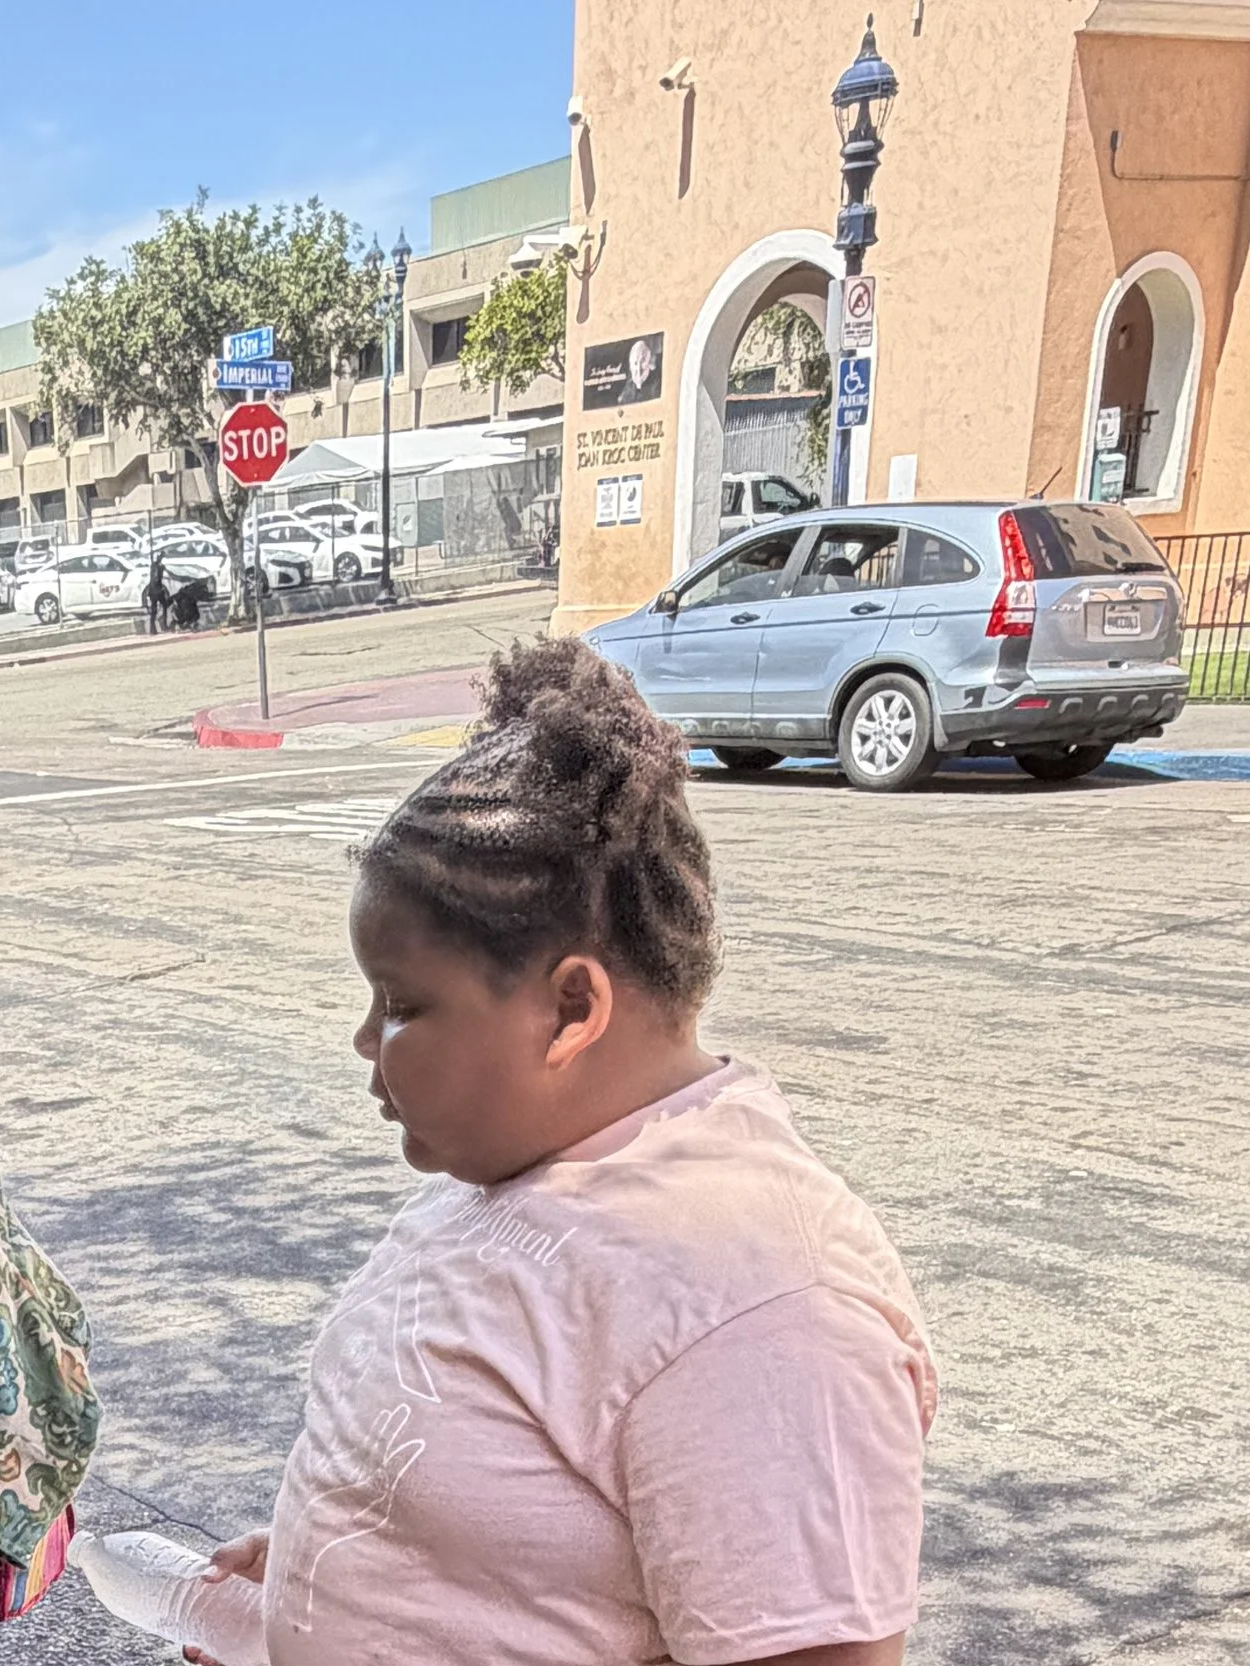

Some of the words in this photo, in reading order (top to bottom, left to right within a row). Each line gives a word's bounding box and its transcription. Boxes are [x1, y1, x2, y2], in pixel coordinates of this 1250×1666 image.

[235, 337, 258, 359] 15TH
[223, 364, 273, 385] IMPERIAL
[838, 392, 869, 408] PARKING
[844, 408, 863, 424] ONLY
[223, 426, 285, 462] STOP
[591, 425, 630, 447] VINCENT
[644, 420, 664, 440] PAUL
[577, 450, 599, 471] JOAN
[628, 442, 661, 462] CENTER
